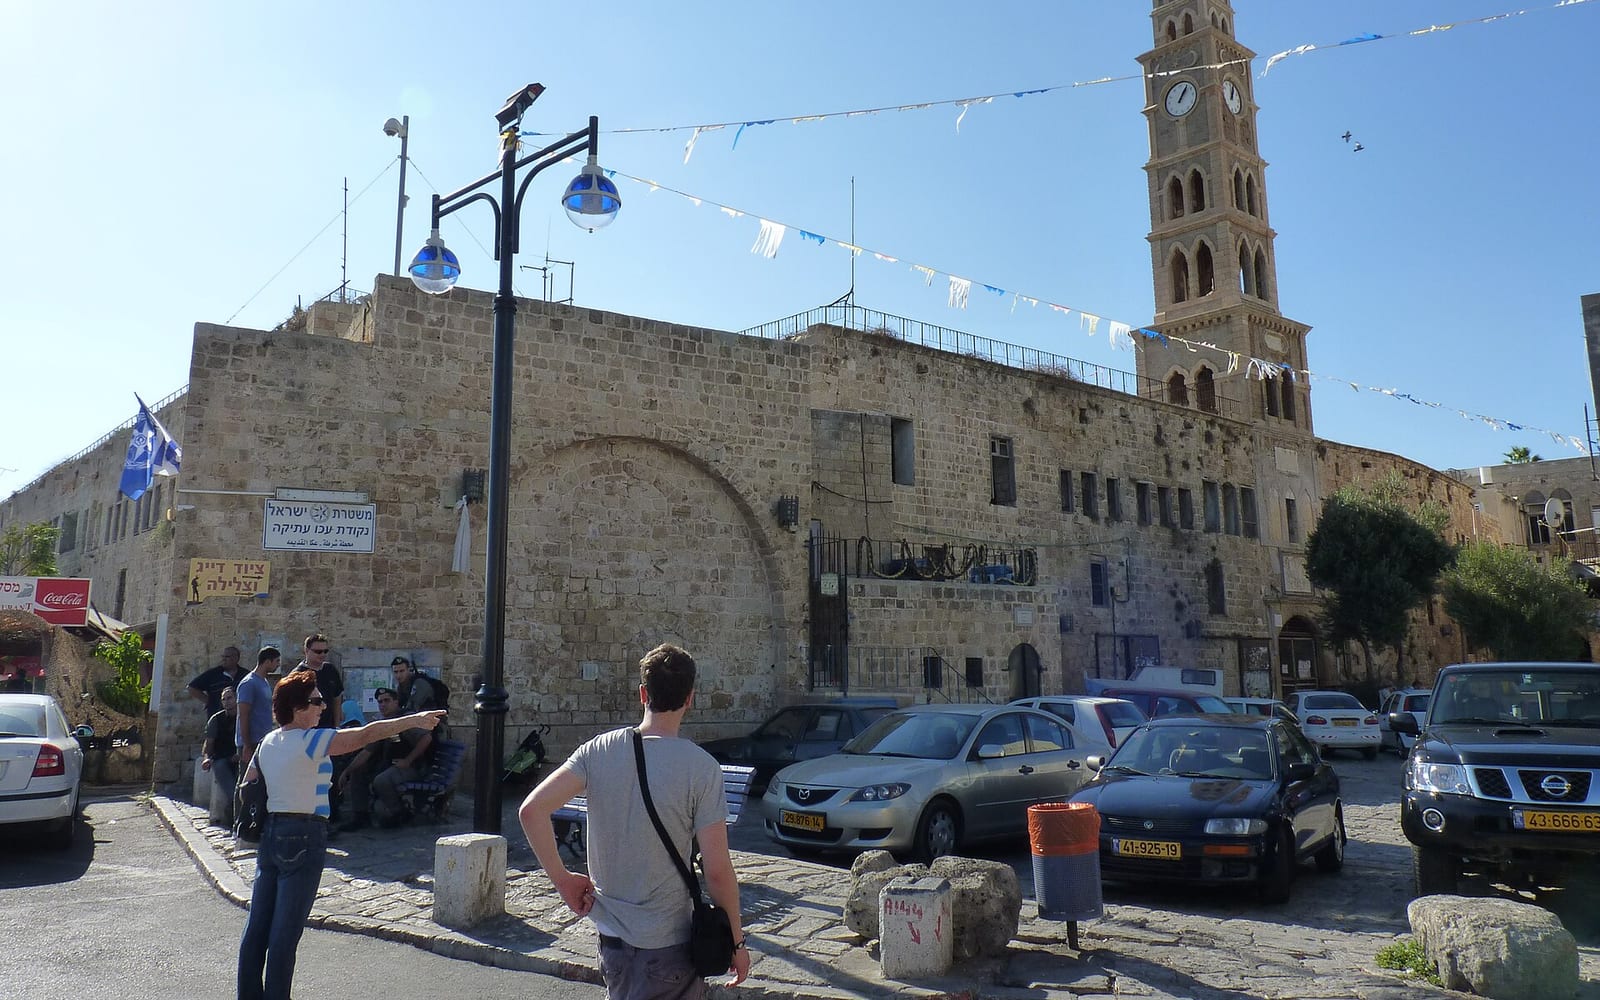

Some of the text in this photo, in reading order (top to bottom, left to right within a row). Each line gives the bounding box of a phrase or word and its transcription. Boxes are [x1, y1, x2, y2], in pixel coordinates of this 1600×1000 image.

[268, 502, 372, 520] משטרת ישראל
[272, 523, 311, 535] עתיקה
[336, 526, 369, 538] נקודת
[196, 562, 265, 575] ציוד דייג
[207, 576, 258, 592] וצלילה
[1123, 841, 1178, 856] 41-925-19
